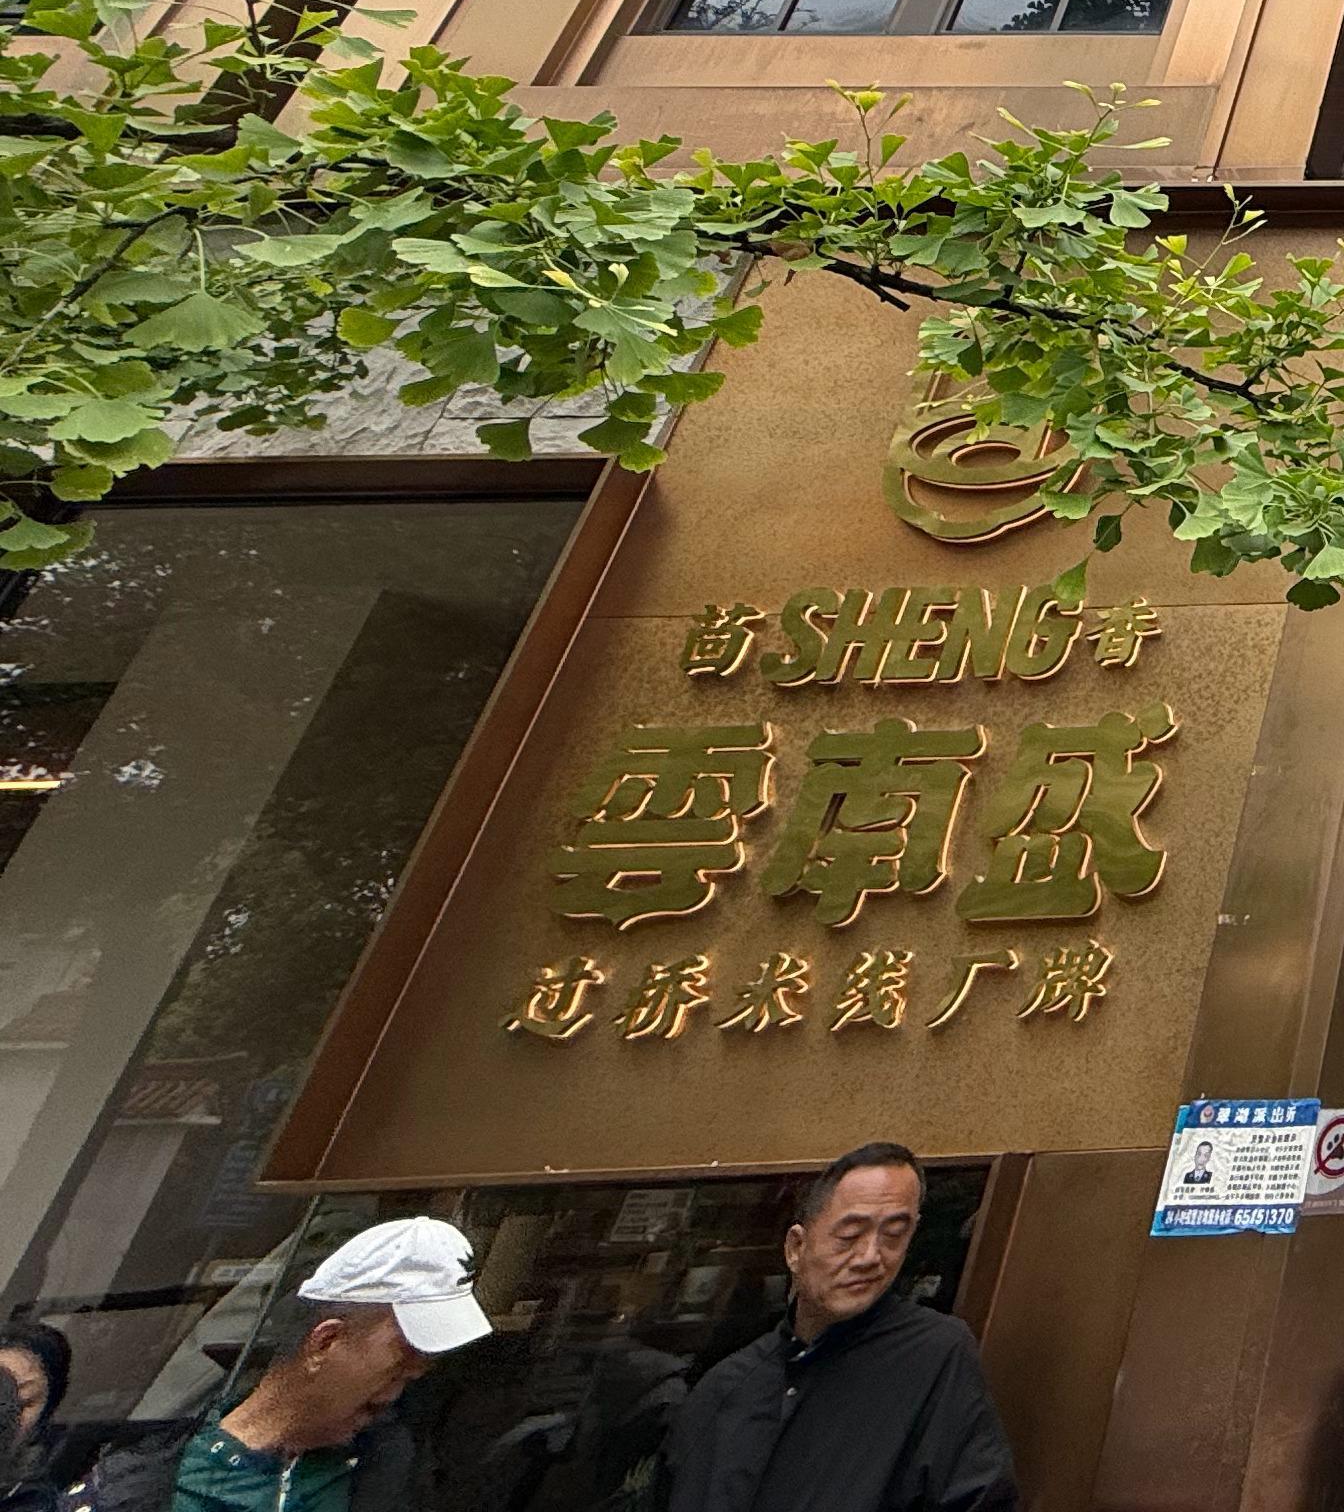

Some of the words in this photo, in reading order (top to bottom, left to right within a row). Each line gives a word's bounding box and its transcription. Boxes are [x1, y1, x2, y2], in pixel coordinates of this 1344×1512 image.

[760, 585, 1085, 687] SHENG
[1087, 599, 1163, 669] 香
[550, 701, 1178, 931] 雲南盛
